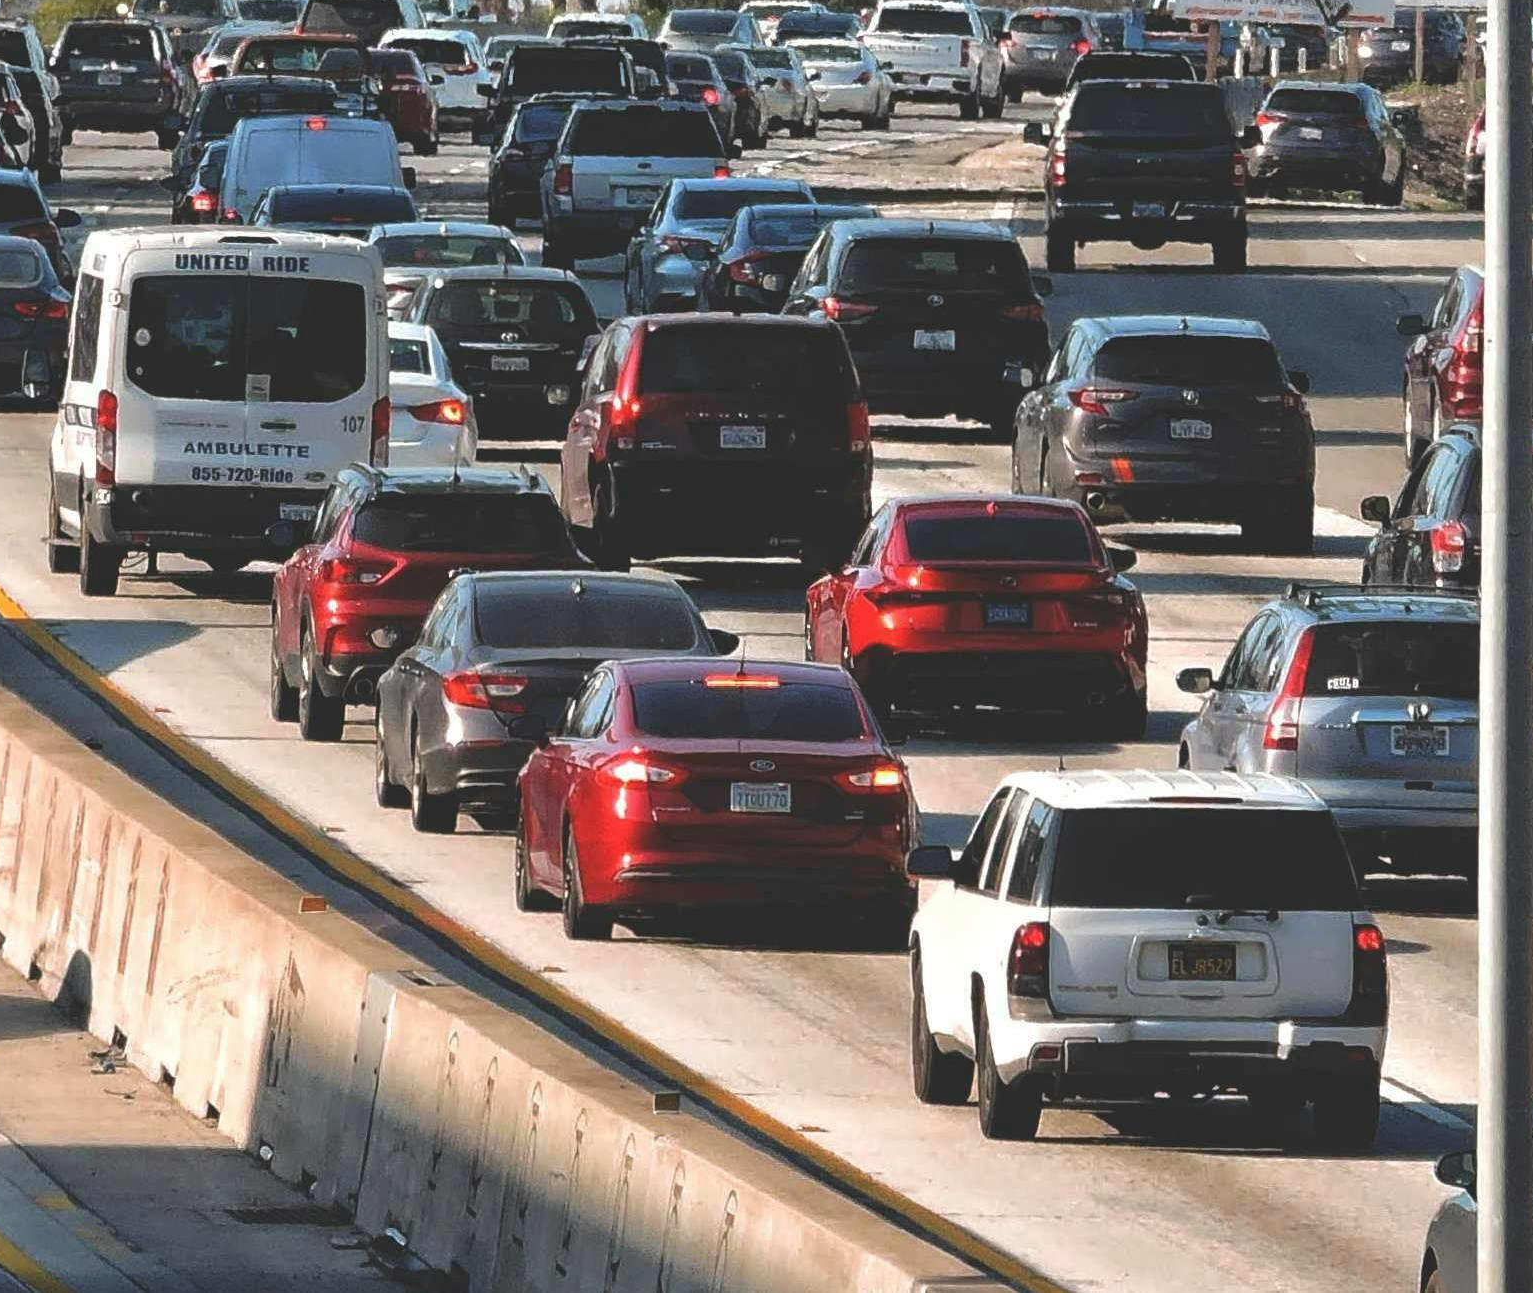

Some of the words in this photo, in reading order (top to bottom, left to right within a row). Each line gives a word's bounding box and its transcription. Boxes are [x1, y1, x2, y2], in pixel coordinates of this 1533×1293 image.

[175, 254, 249, 271] UNITED
[263, 256, 310, 273] RIDE
[340, 415, 365, 433] 107
[183, 442, 310, 458] AMBULETTE
